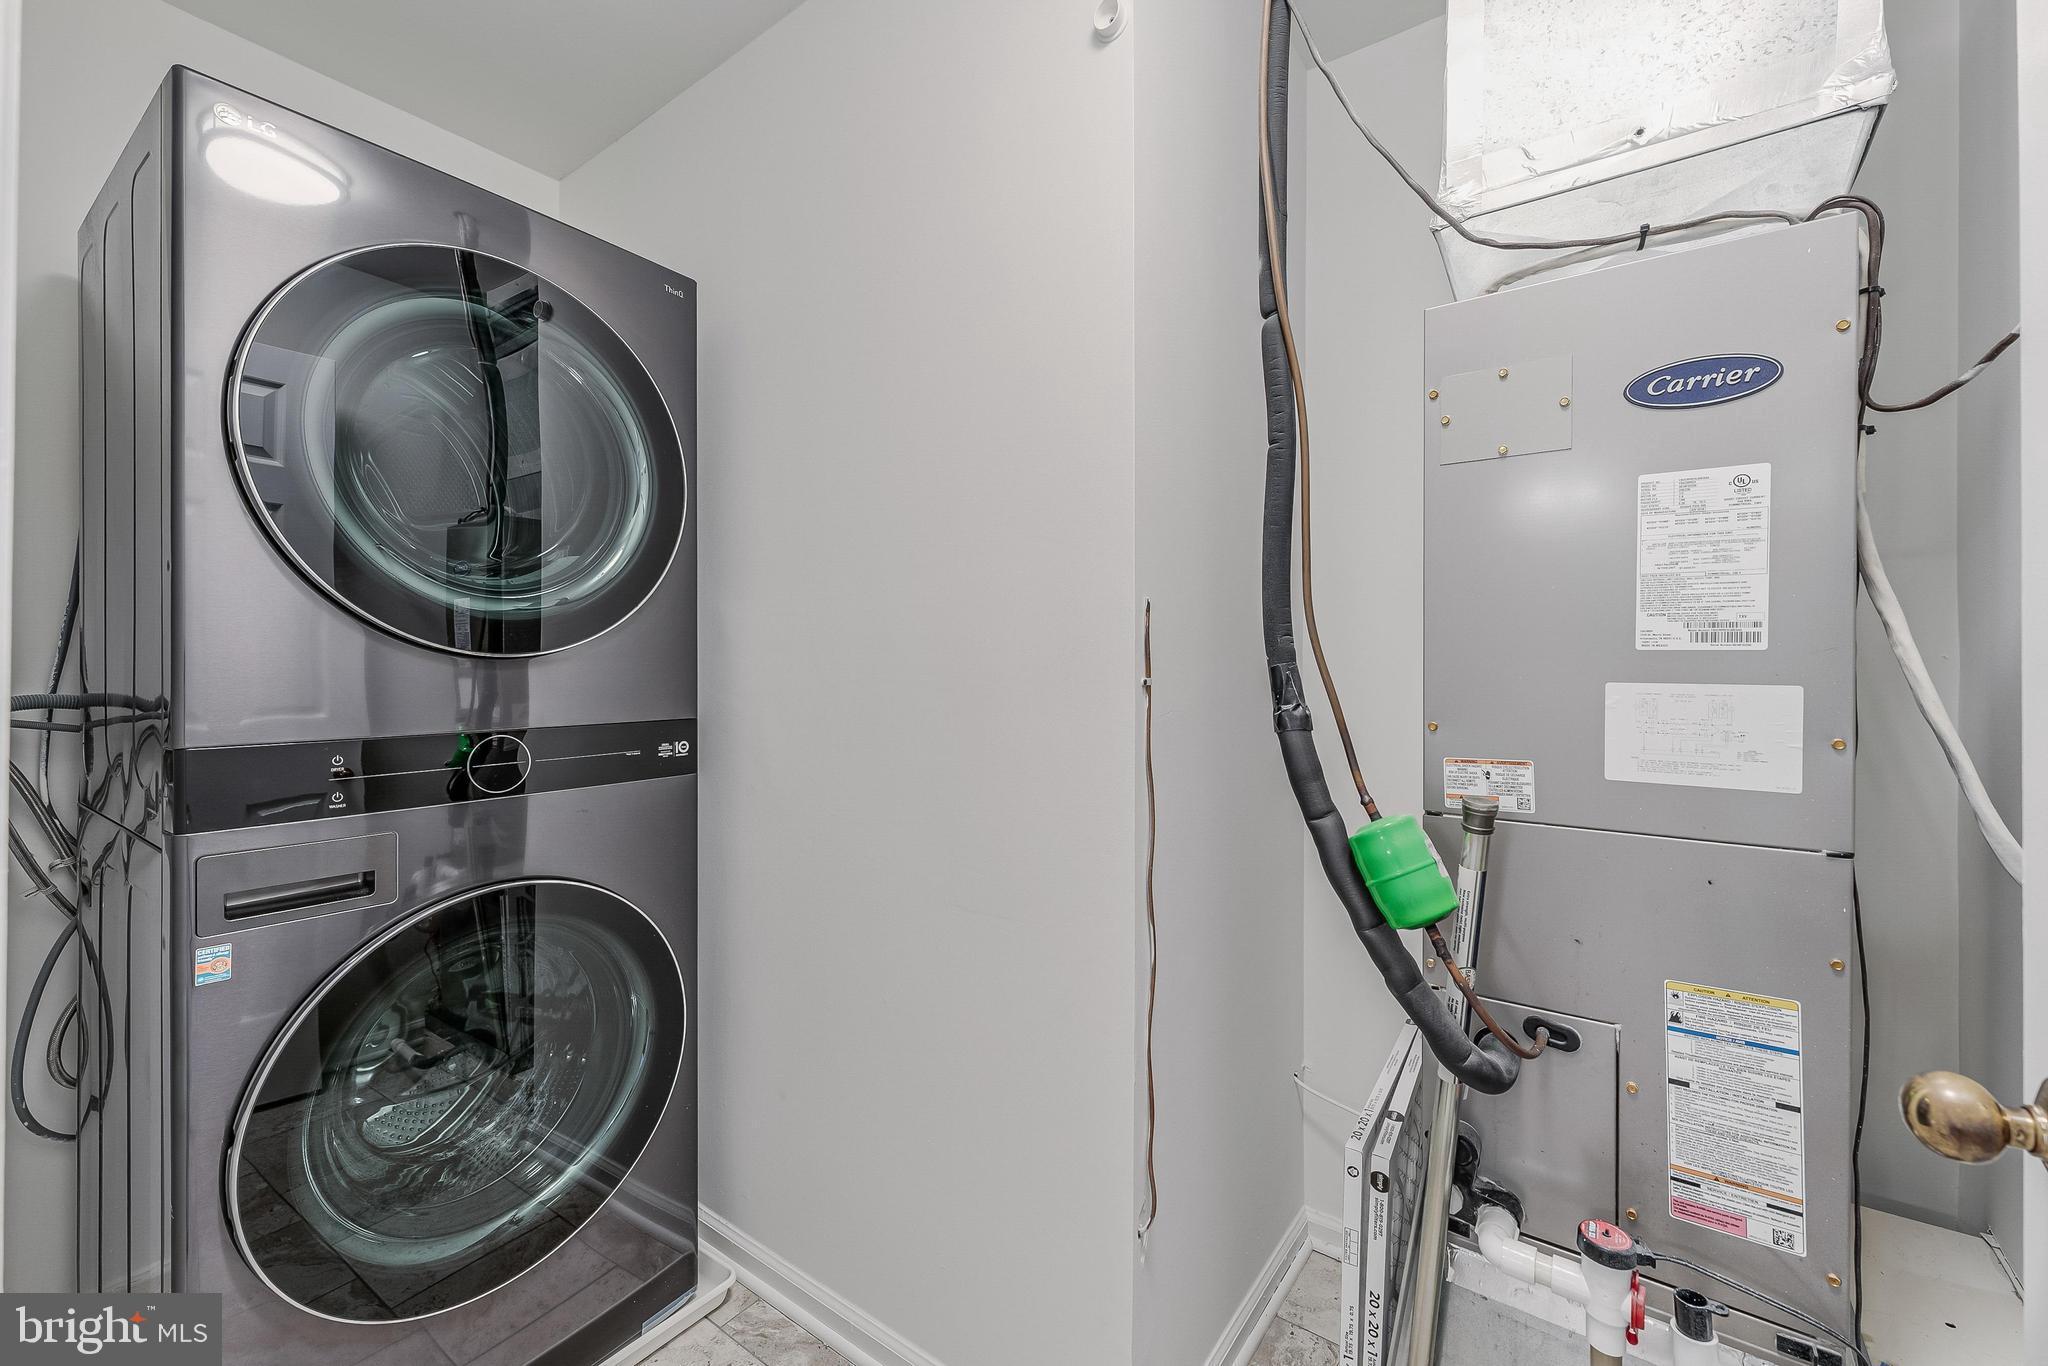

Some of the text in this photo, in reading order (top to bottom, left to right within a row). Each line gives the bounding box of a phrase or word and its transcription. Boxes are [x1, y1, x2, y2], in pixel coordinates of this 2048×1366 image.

[247, 115, 277, 138] LG
[664, 283, 684, 298] ThinQ
[1646, 366, 1761, 396] Carrier
[1737, 476, 1746, 485] UL
[197, 945, 230, 956] CERTIFIED
[1351, 1130, 1363, 1142] 20
[1358, 1117, 1370, 1127] 20
[1369, 1290, 1381, 1309] 20
[1367, 1320, 1379, 1339] 20
